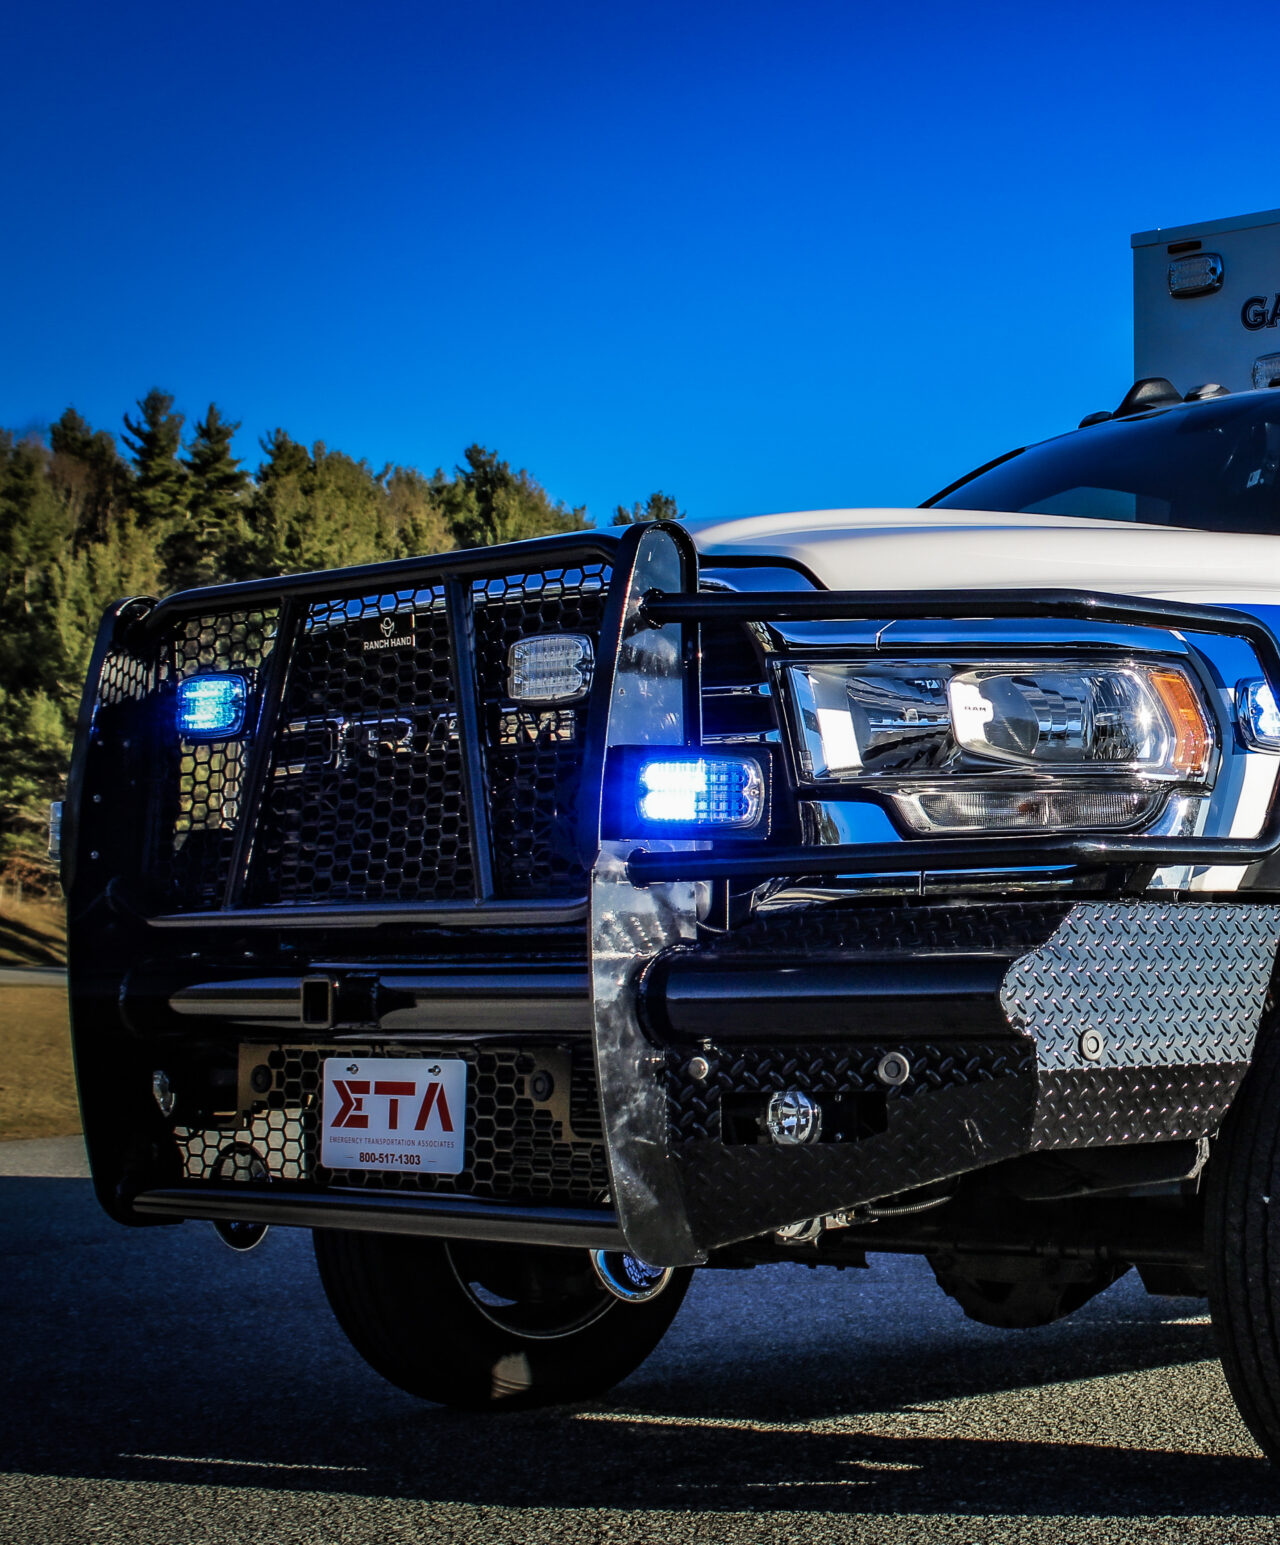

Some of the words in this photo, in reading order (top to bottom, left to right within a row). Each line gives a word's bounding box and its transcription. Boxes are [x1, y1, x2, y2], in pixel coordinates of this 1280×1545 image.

[363, 639, 390, 651] RANCH
[390, 636, 412, 647] HAND
[329, 1135, 363, 1145] EMERGENCY
[364, 1137, 416, 1147] TRANSPORTATION
[417, 1140, 455, 1149] ASSOCIATES
[359, 1151, 421, 1166] 800-517-1303
